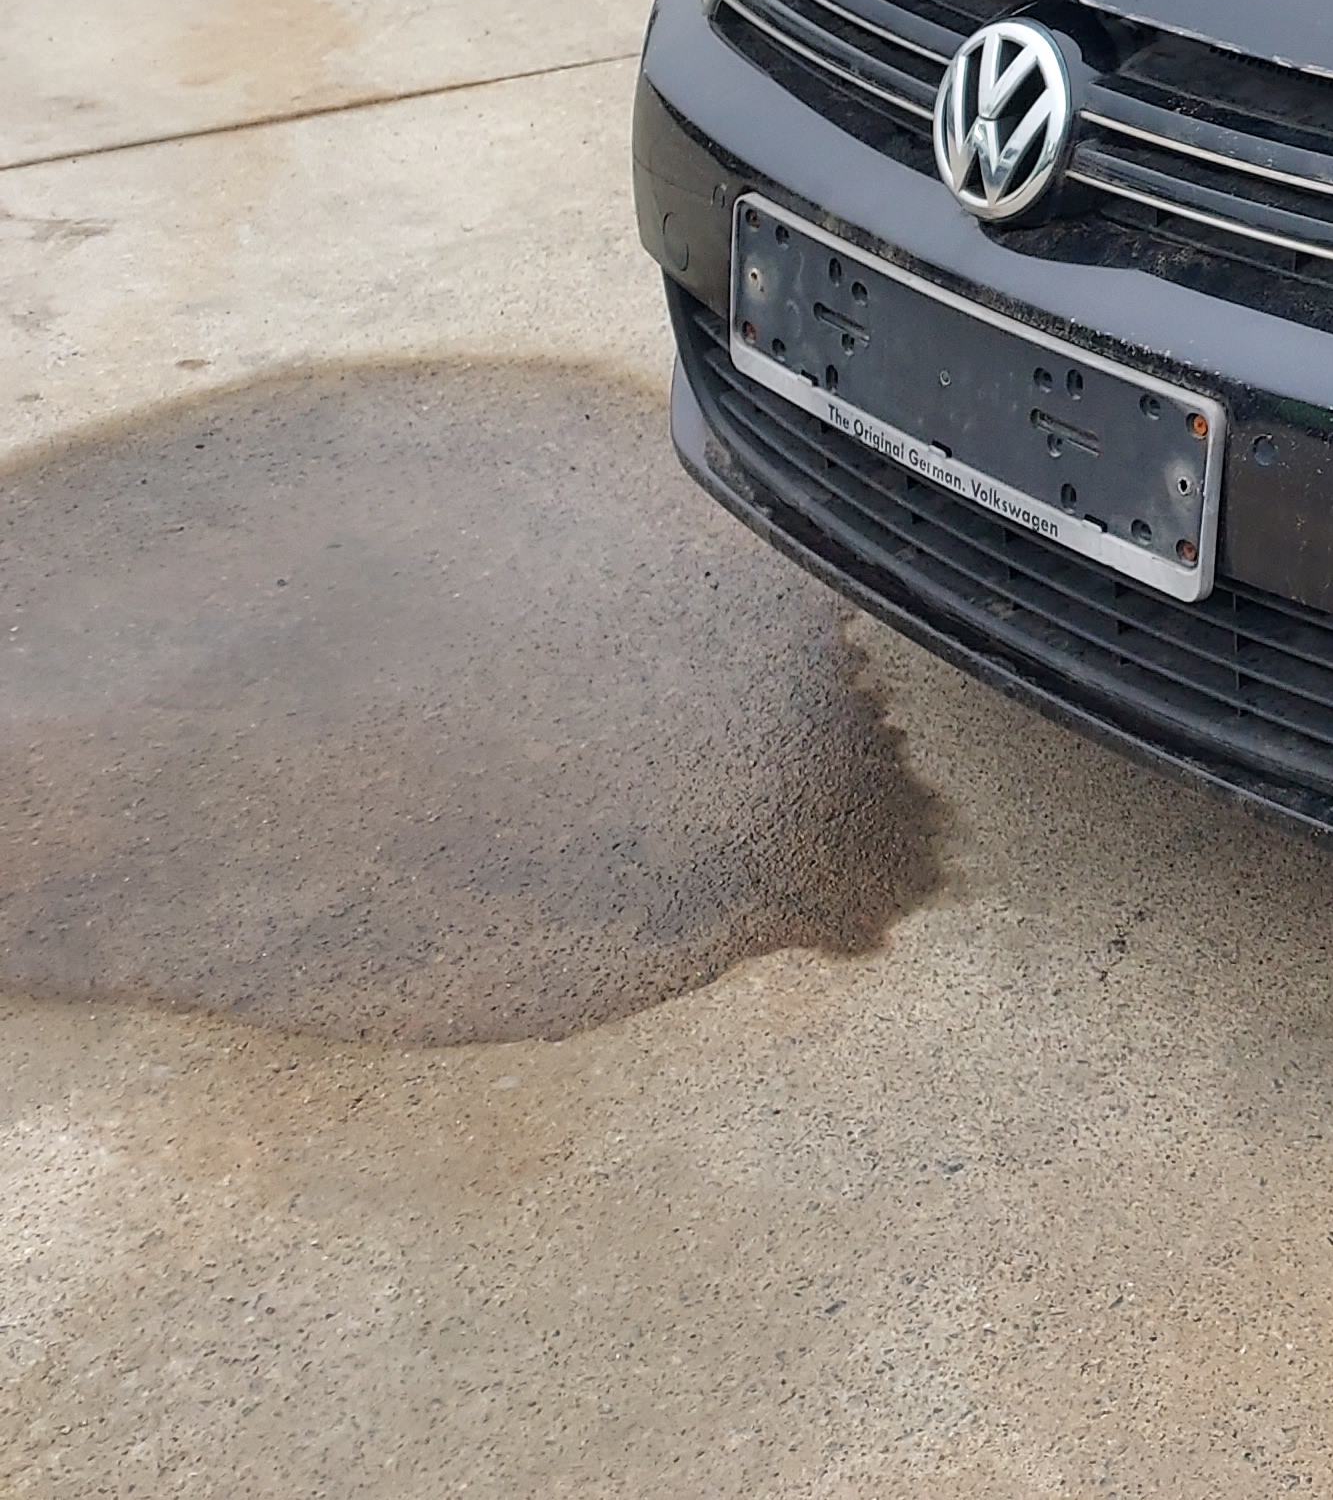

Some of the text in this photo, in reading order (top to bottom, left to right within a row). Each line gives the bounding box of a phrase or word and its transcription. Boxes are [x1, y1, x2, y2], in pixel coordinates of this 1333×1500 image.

[827, 403, 850, 429] The
[853, 418, 905, 461] Original
[970, 478, 1059, 538] Volkswagen
